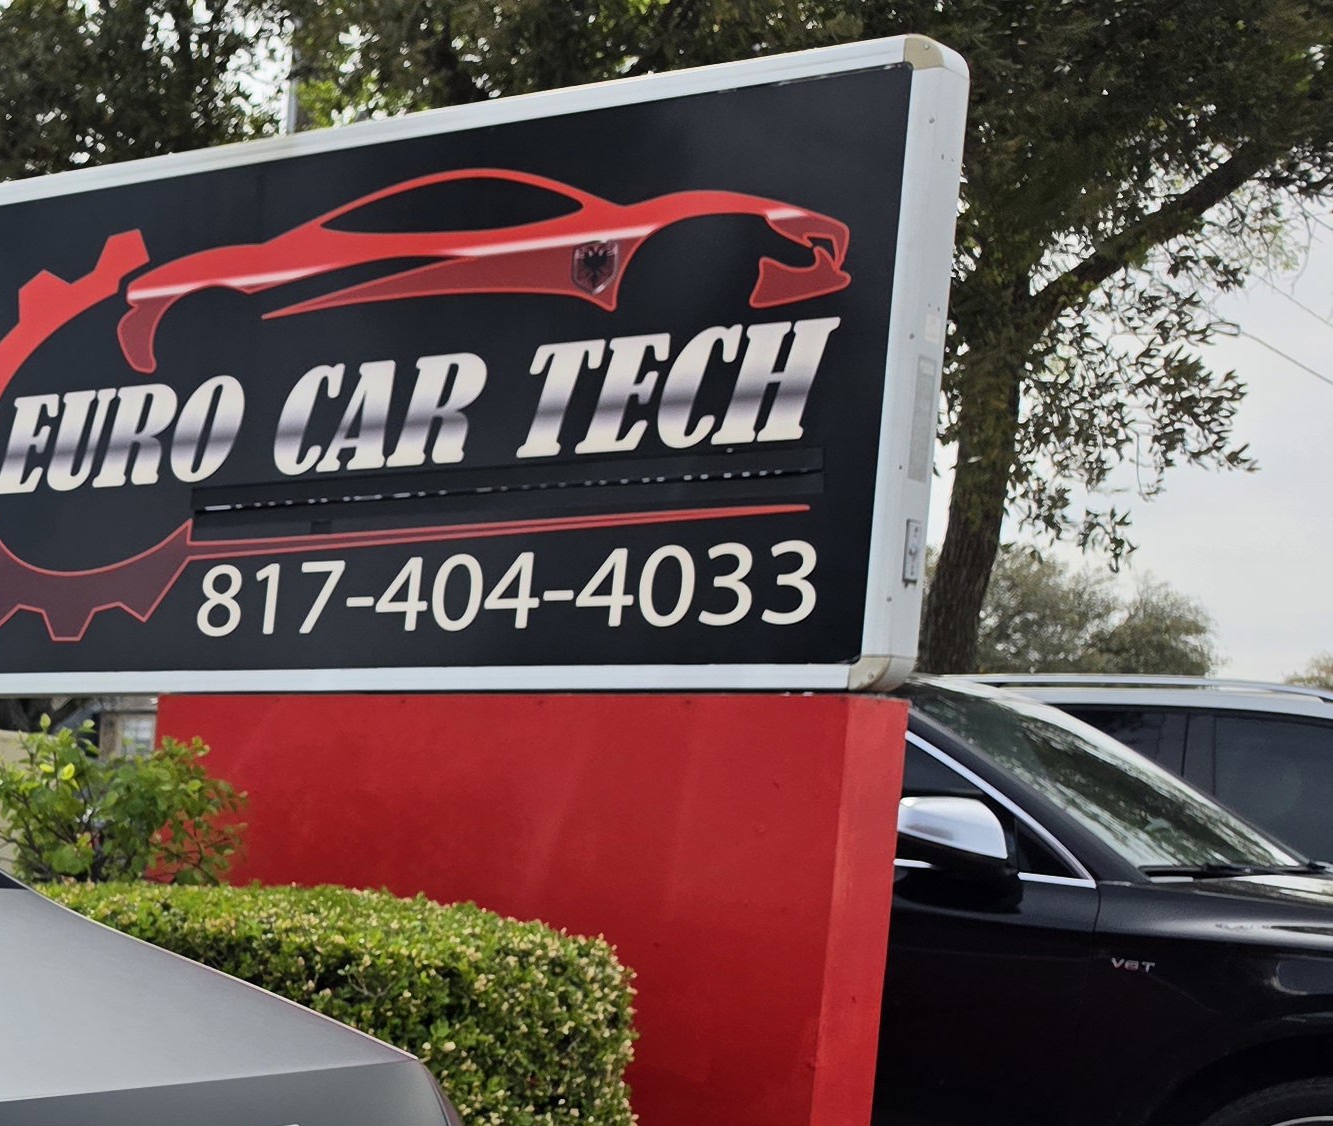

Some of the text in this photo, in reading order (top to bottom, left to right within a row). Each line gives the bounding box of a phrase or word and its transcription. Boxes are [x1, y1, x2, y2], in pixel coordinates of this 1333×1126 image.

[273, 351, 488, 476] CAR
[516, 316, 841, 459] TECH
[196, 539, 818, 638] 817-404-4033
